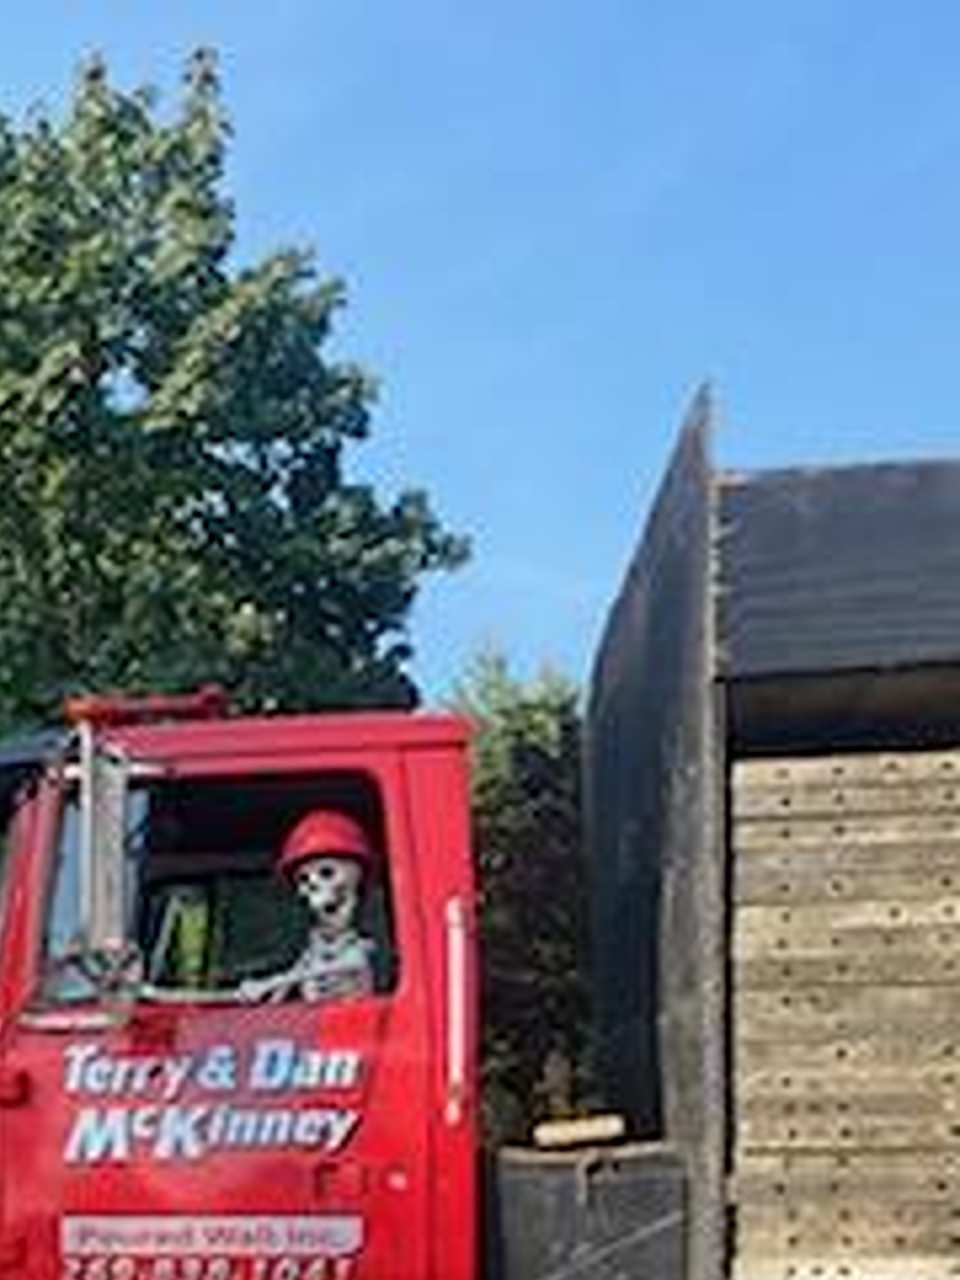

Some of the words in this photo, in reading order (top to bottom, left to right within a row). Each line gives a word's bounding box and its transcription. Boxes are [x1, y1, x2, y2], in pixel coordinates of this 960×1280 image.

[64, 1044, 193, 1099] Terry
[196, 1045, 236, 1089] &
[249, 1038, 360, 1091] Dan
[63, 1105, 361, 1161] McKinney
